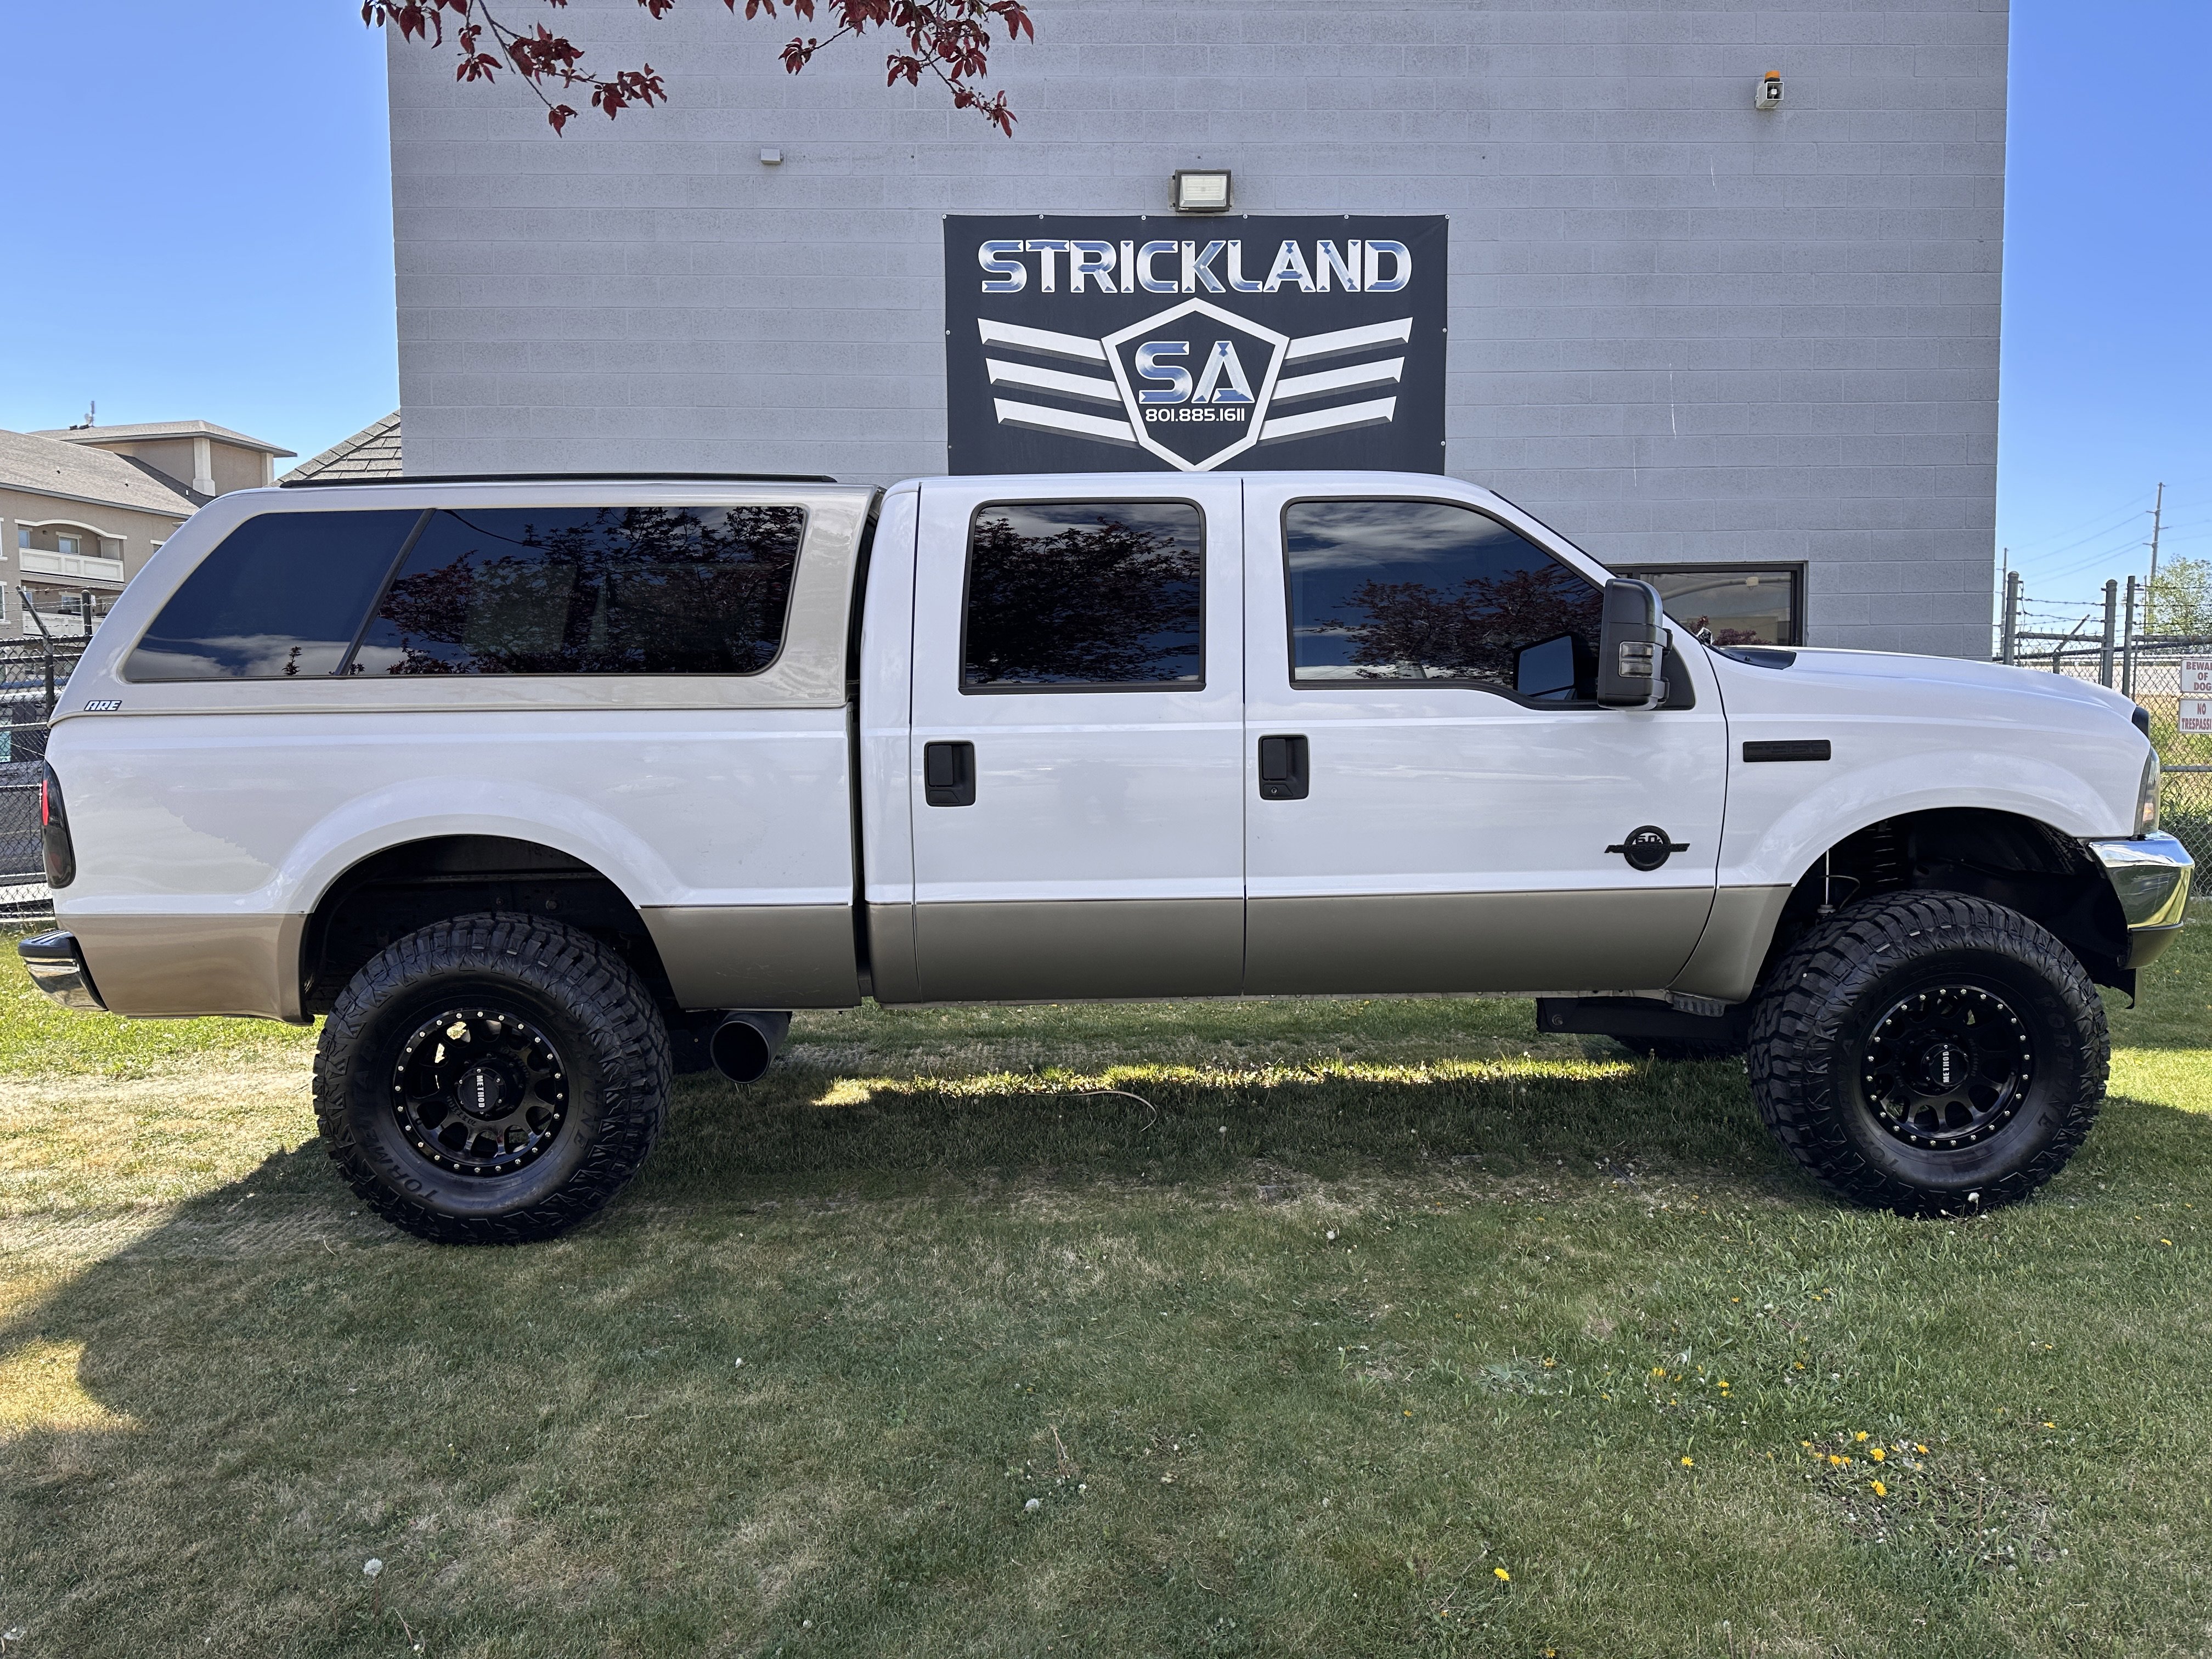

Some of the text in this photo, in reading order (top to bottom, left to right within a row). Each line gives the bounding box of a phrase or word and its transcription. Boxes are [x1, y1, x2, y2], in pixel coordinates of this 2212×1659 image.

[978, 240, 1413, 293] STRICKLAND
[1135, 341, 1255, 404] SA
[1146, 408, 1245, 422] 801.885.1611
[2197, 672, 2208, 680] OF
[2194, 682, 2211, 691] DOG
[84, 701, 121, 710] ARE
[2197, 703, 2206, 715] NO
[476, 1075, 485, 1108] METHOD
